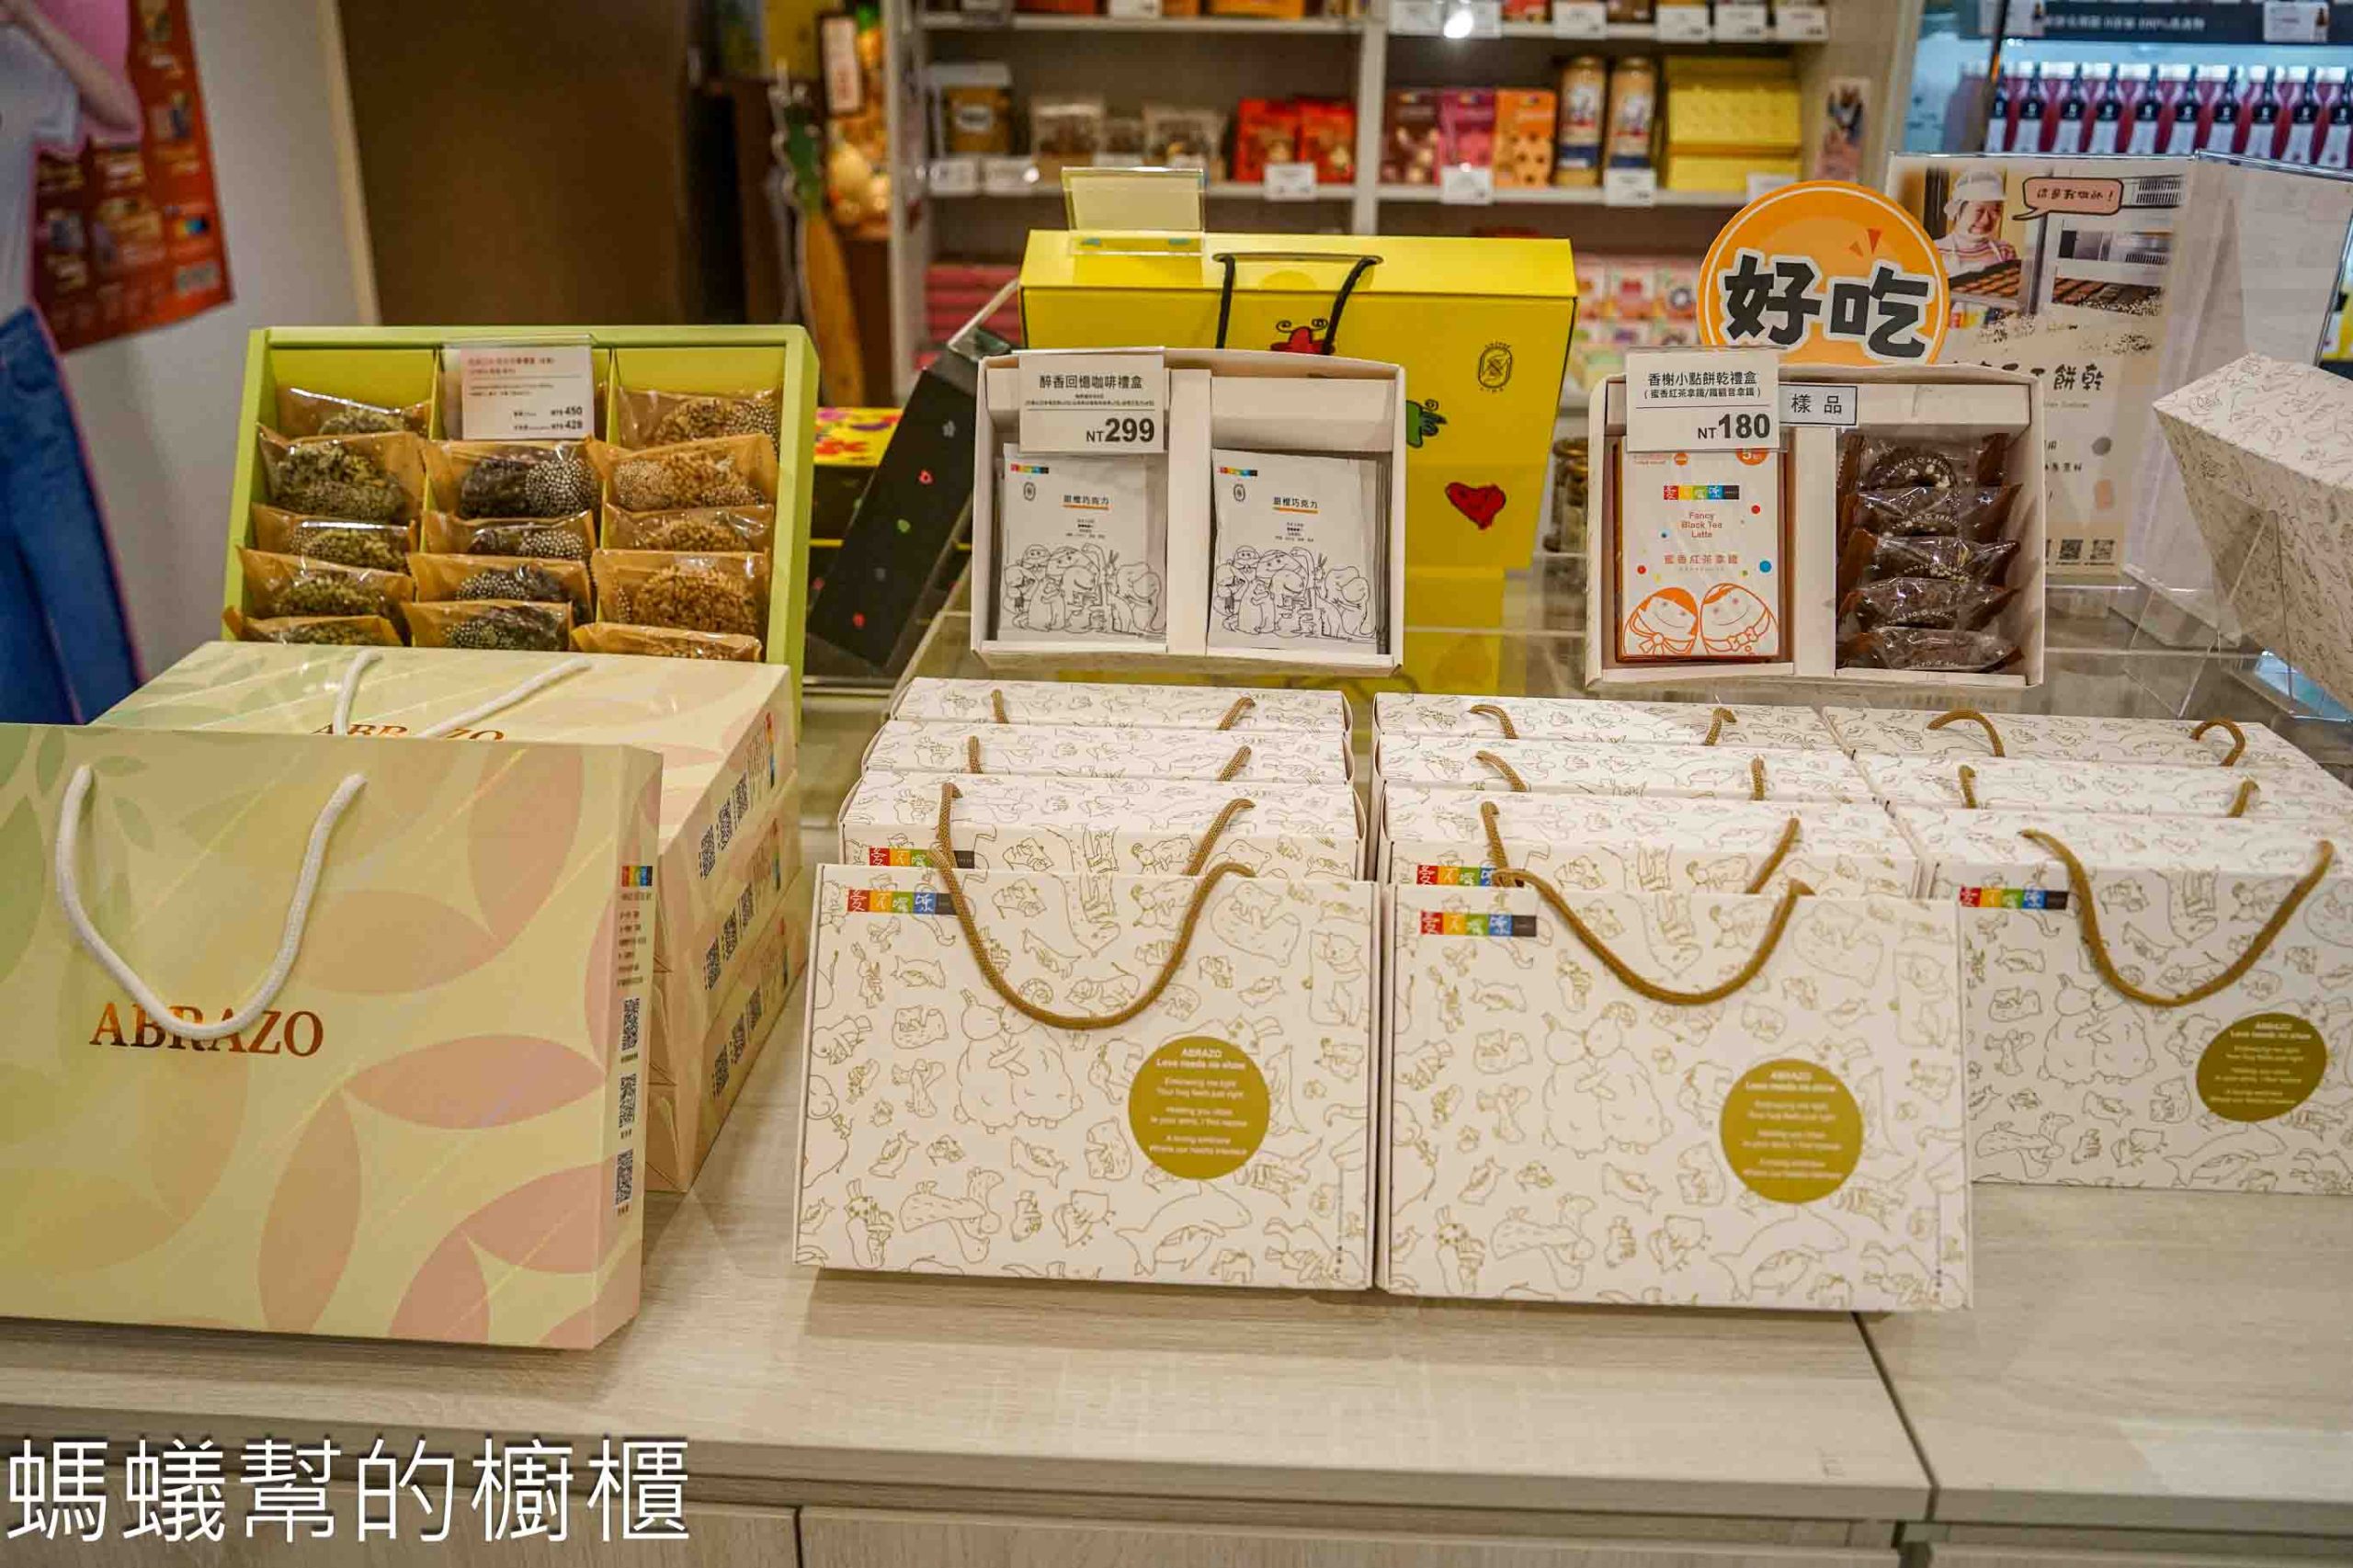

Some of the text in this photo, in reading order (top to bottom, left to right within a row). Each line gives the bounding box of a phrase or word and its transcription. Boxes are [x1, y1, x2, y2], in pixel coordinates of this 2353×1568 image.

[1724, 254, 1929, 358] 好吃
[1039, 374, 1142, 389] 醉香回憶咖啡禮盒
[1648, 370, 1758, 387] 香榭小點餅乾禮盒
[1790, 393, 1843, 414] 樣品
